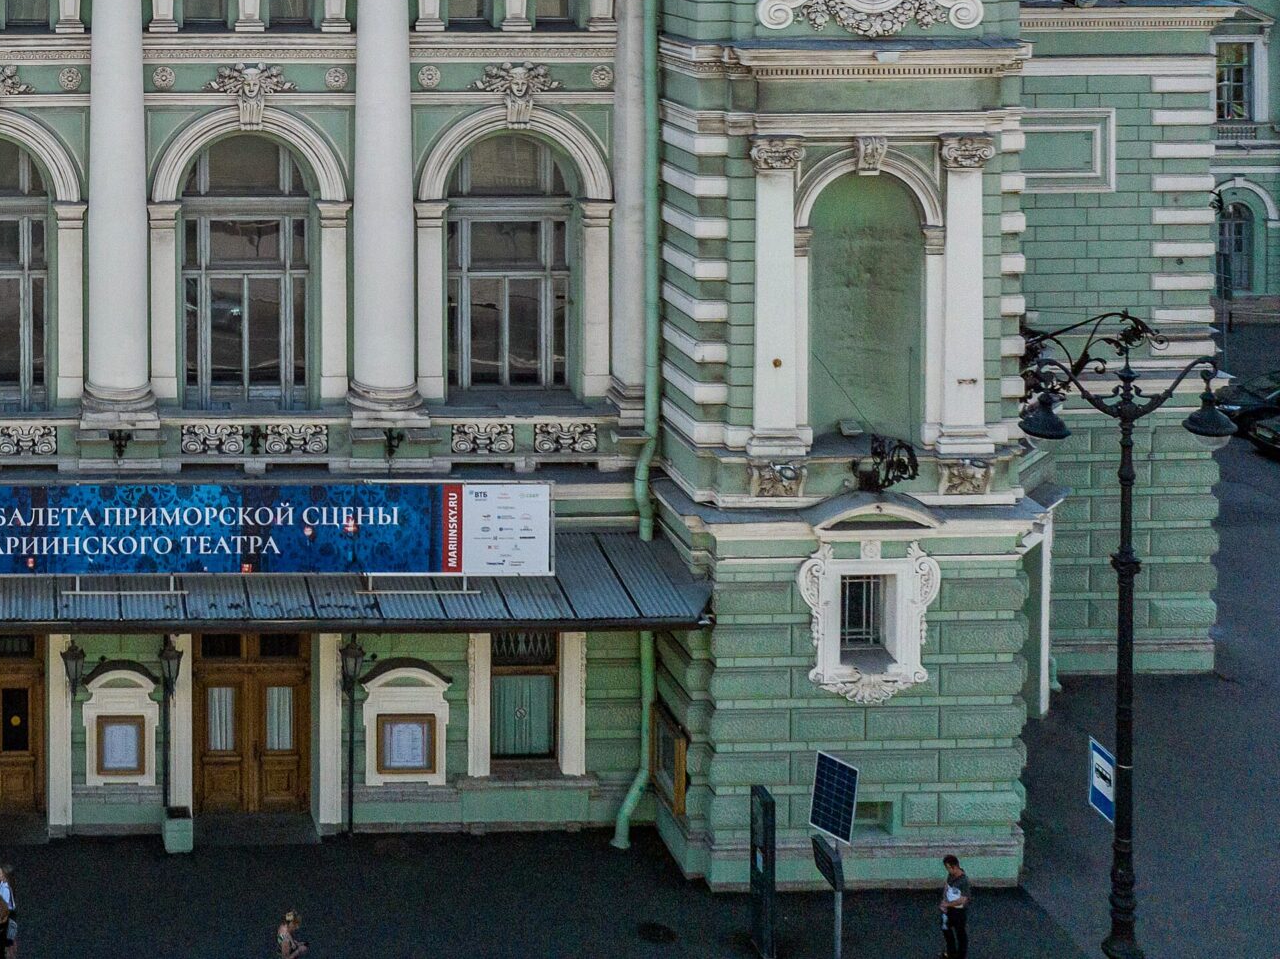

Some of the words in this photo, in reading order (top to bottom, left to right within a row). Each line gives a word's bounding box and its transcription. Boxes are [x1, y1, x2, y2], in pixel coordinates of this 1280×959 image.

[103, 502, 294, 527] ПРИМОРСКОЙ
[302, 506, 399, 529] СЦЕНЫ
[447, 492, 458, 568] MARIINSKY.RU
[181, 536, 281, 554] ТЕАТРА
